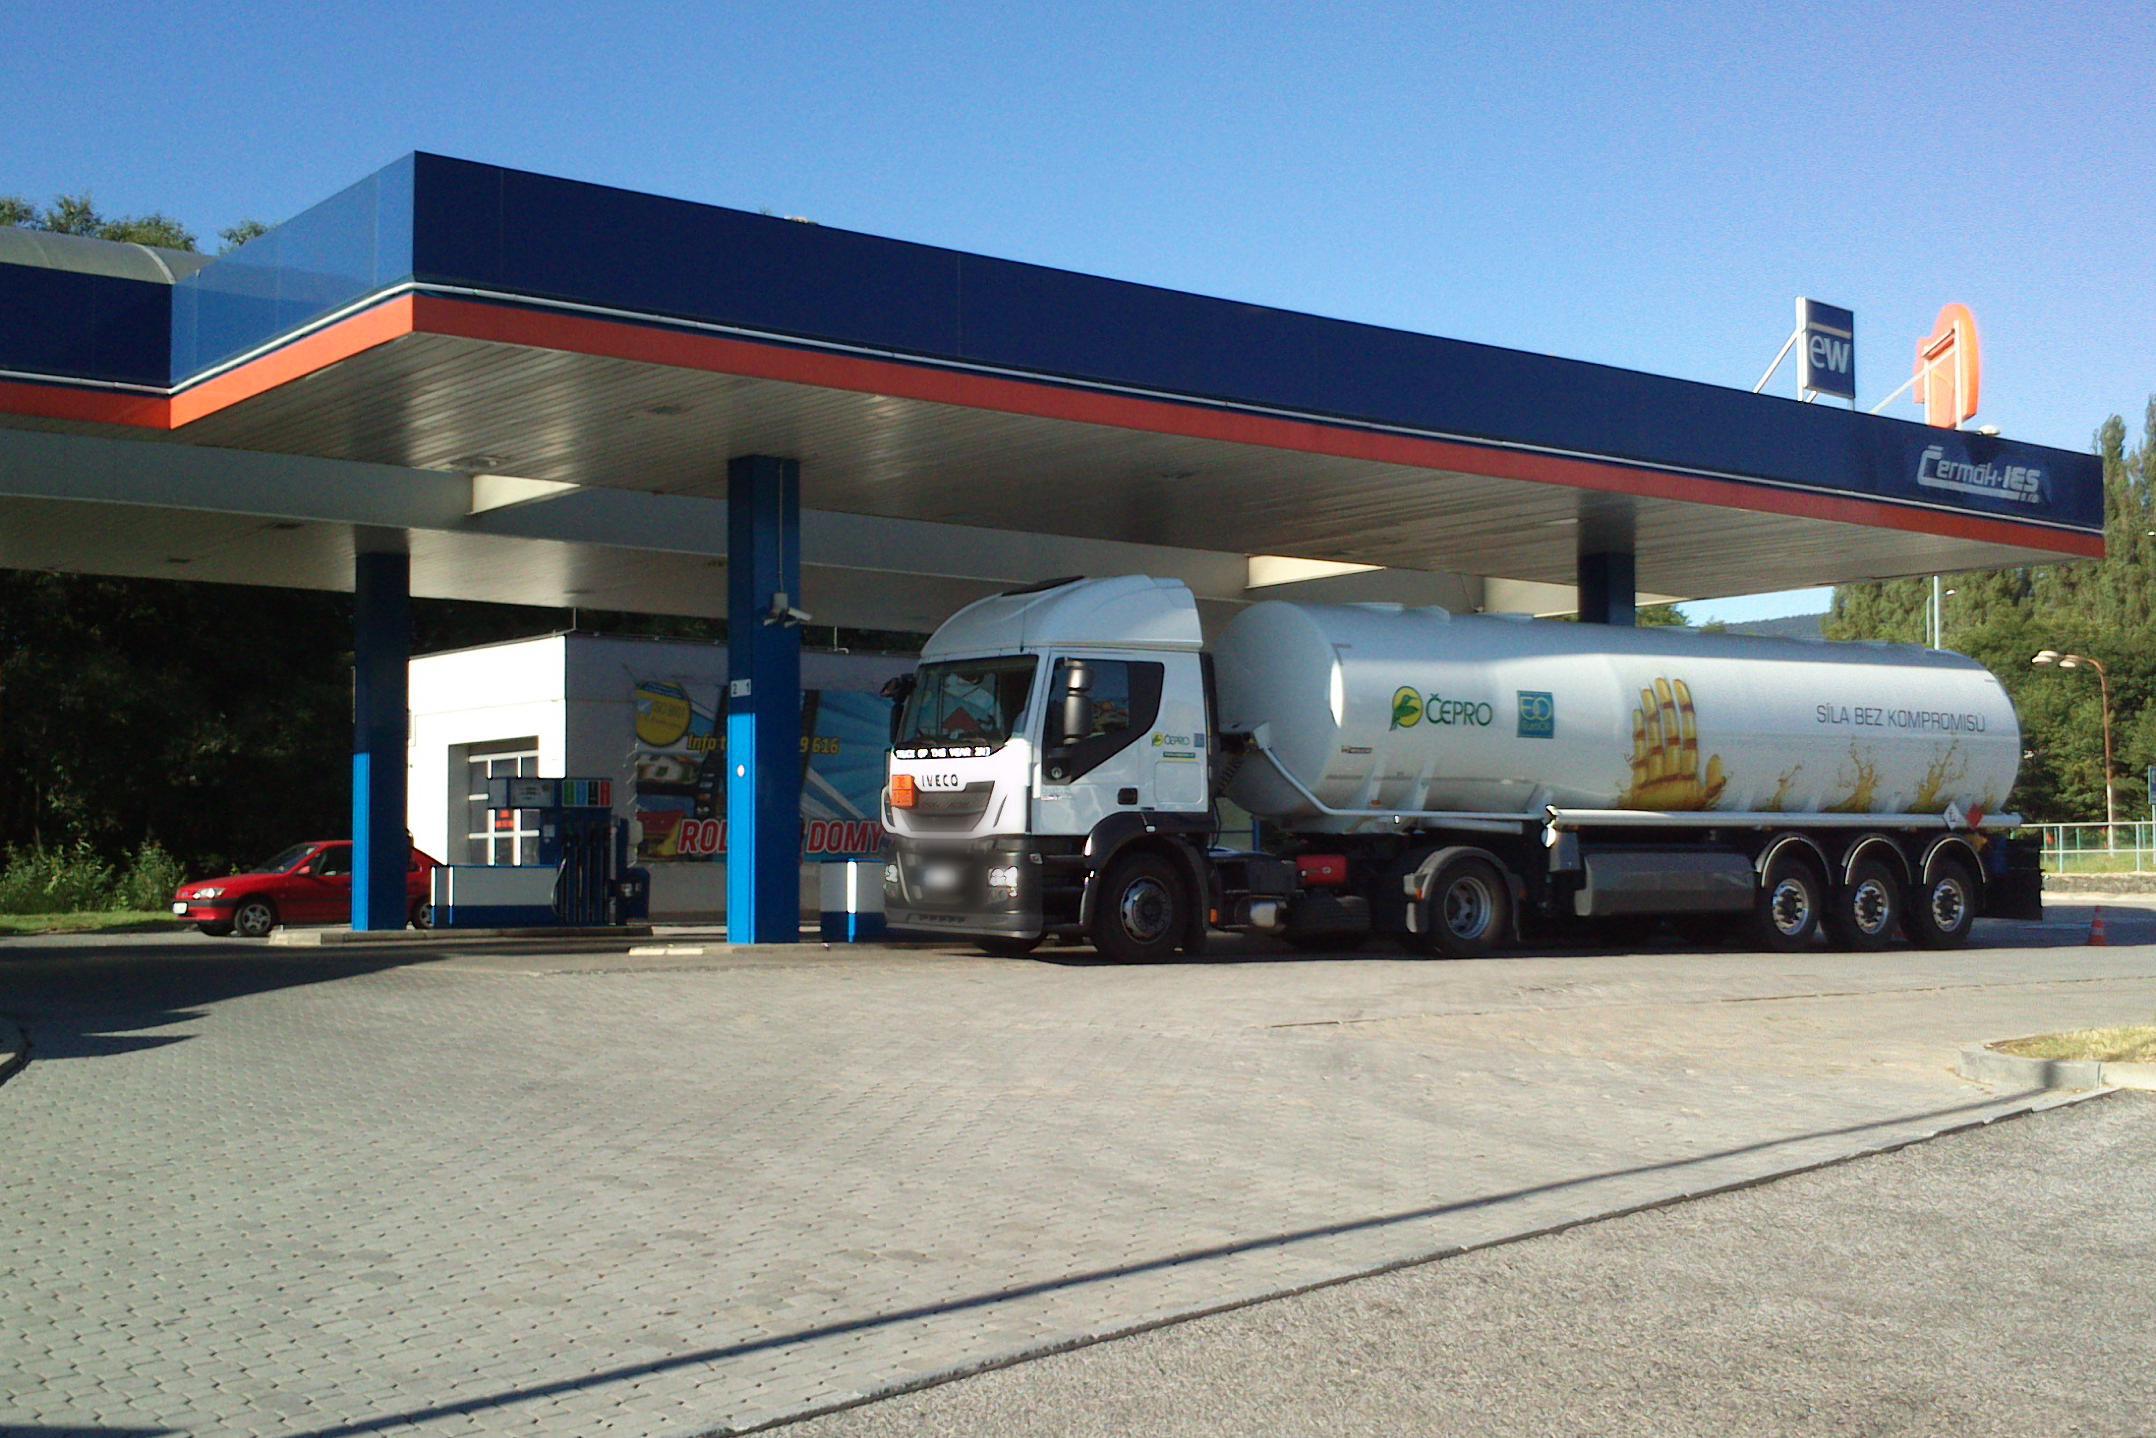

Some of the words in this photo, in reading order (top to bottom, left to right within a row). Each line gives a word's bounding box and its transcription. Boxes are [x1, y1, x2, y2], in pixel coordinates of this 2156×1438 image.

[1425, 693, 1493, 727] ČEPRO
[1816, 702, 1850, 724] SÍLA
[1855, 707, 1883, 727] BEZ
[687, 732, 718, 753] Info
[922, 773, 958, 787] IVECO
[806, 819, 885, 854] DOMY
